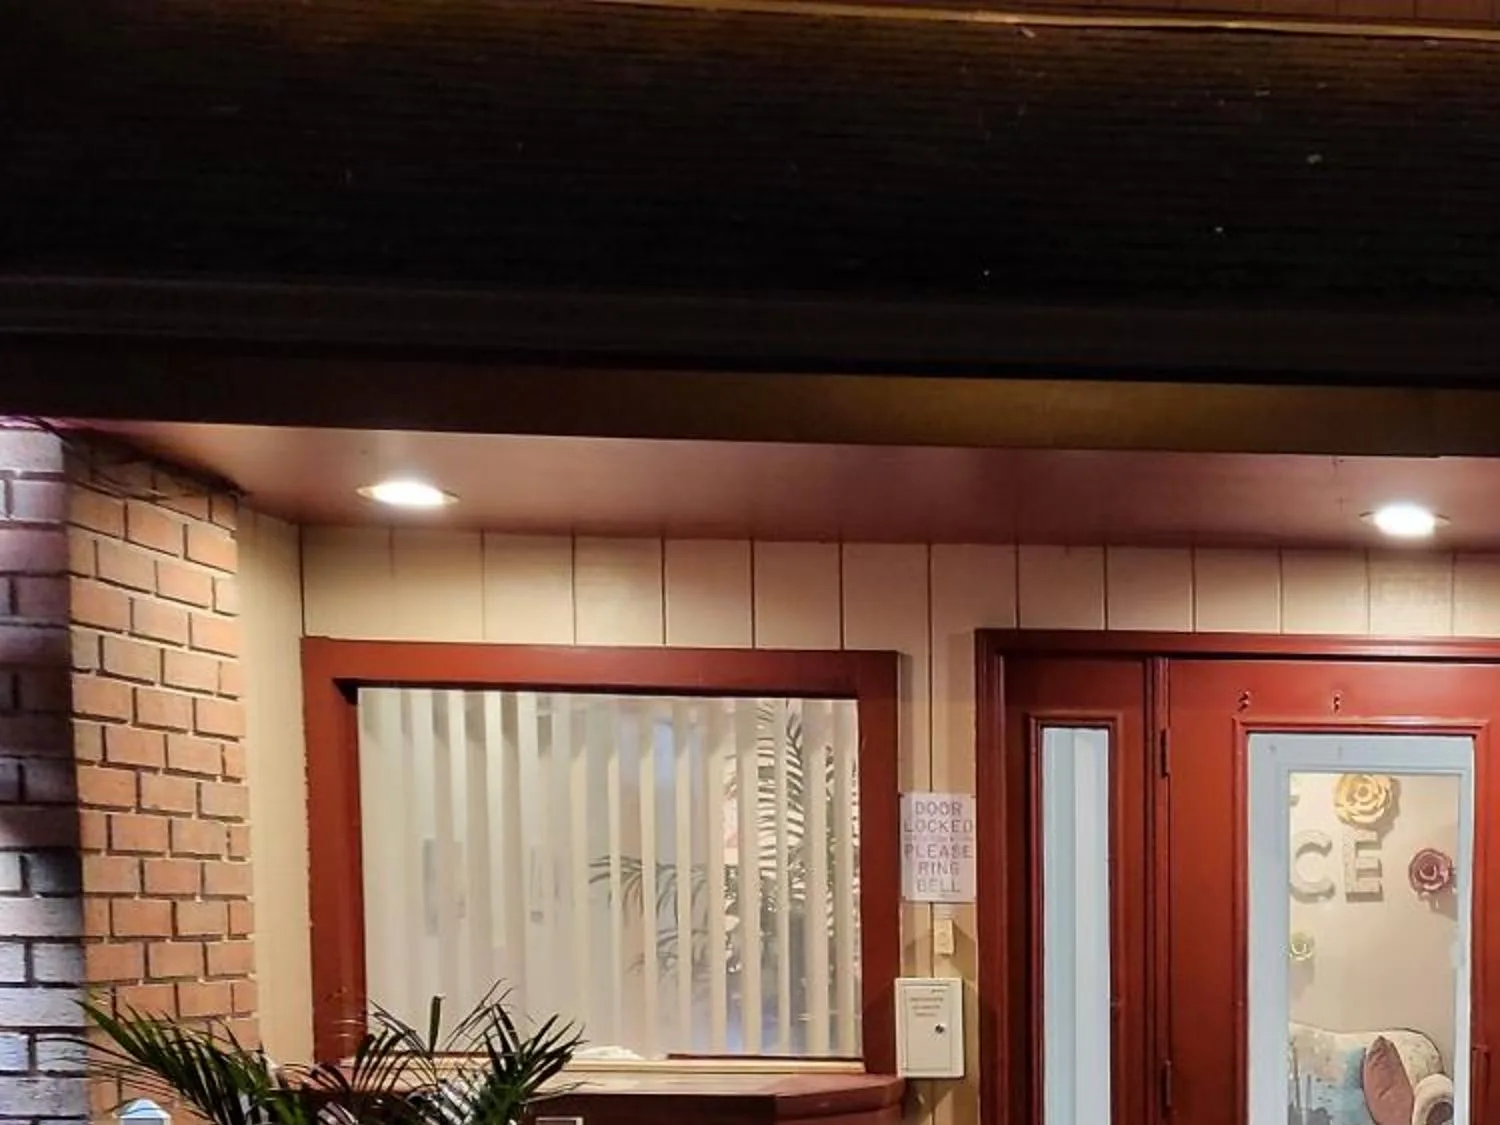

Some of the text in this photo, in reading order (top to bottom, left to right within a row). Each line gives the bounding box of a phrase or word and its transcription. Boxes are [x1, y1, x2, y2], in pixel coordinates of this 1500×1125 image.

[915, 801, 963, 816] DOOR
[903, 819, 973, 833] LOCKED
[904, 843, 974, 859] PLEASE
[918, 861, 960, 876] RING
[917, 879, 961, 892] BELL
